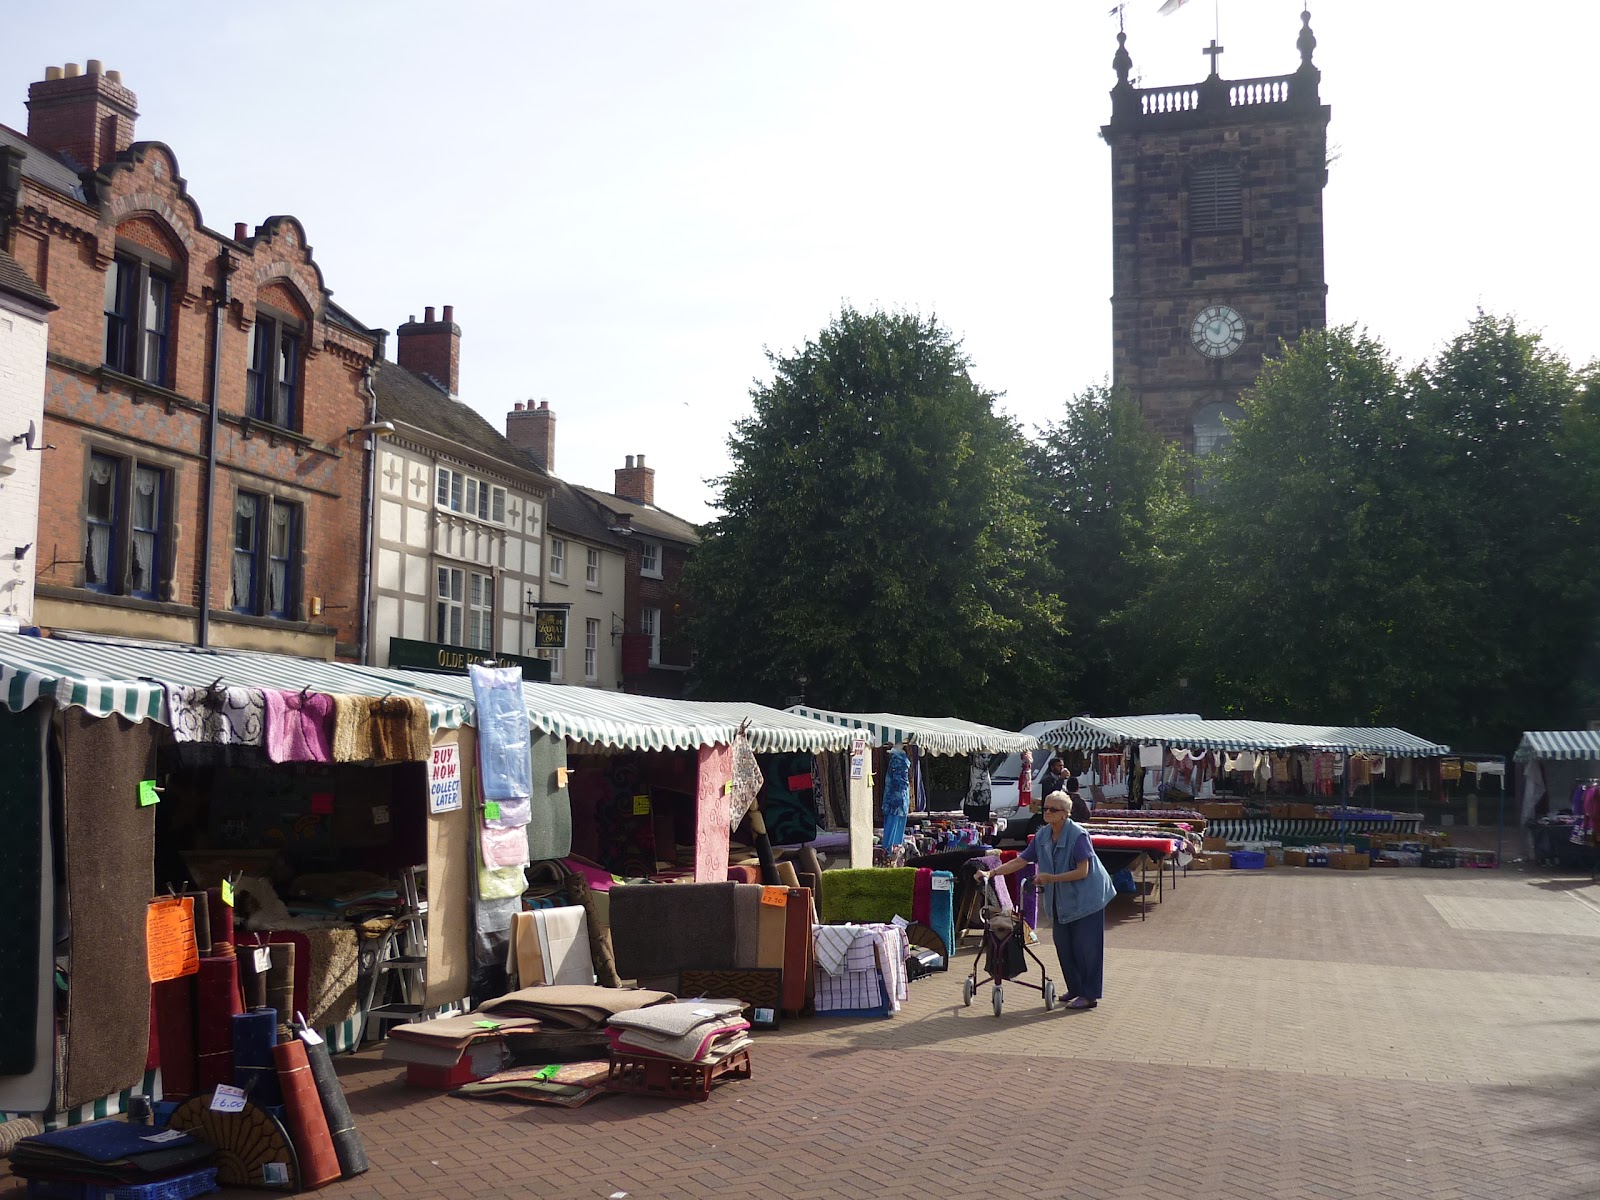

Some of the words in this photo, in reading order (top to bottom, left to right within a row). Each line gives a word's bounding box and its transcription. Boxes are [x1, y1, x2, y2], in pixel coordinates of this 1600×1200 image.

[438, 649, 464, 669] OLDE
[433, 748, 453, 765] BUY
[433, 764, 456, 780] NOW
[432, 780, 460, 795] COLLECT
[436, 792, 457, 806] LATER
